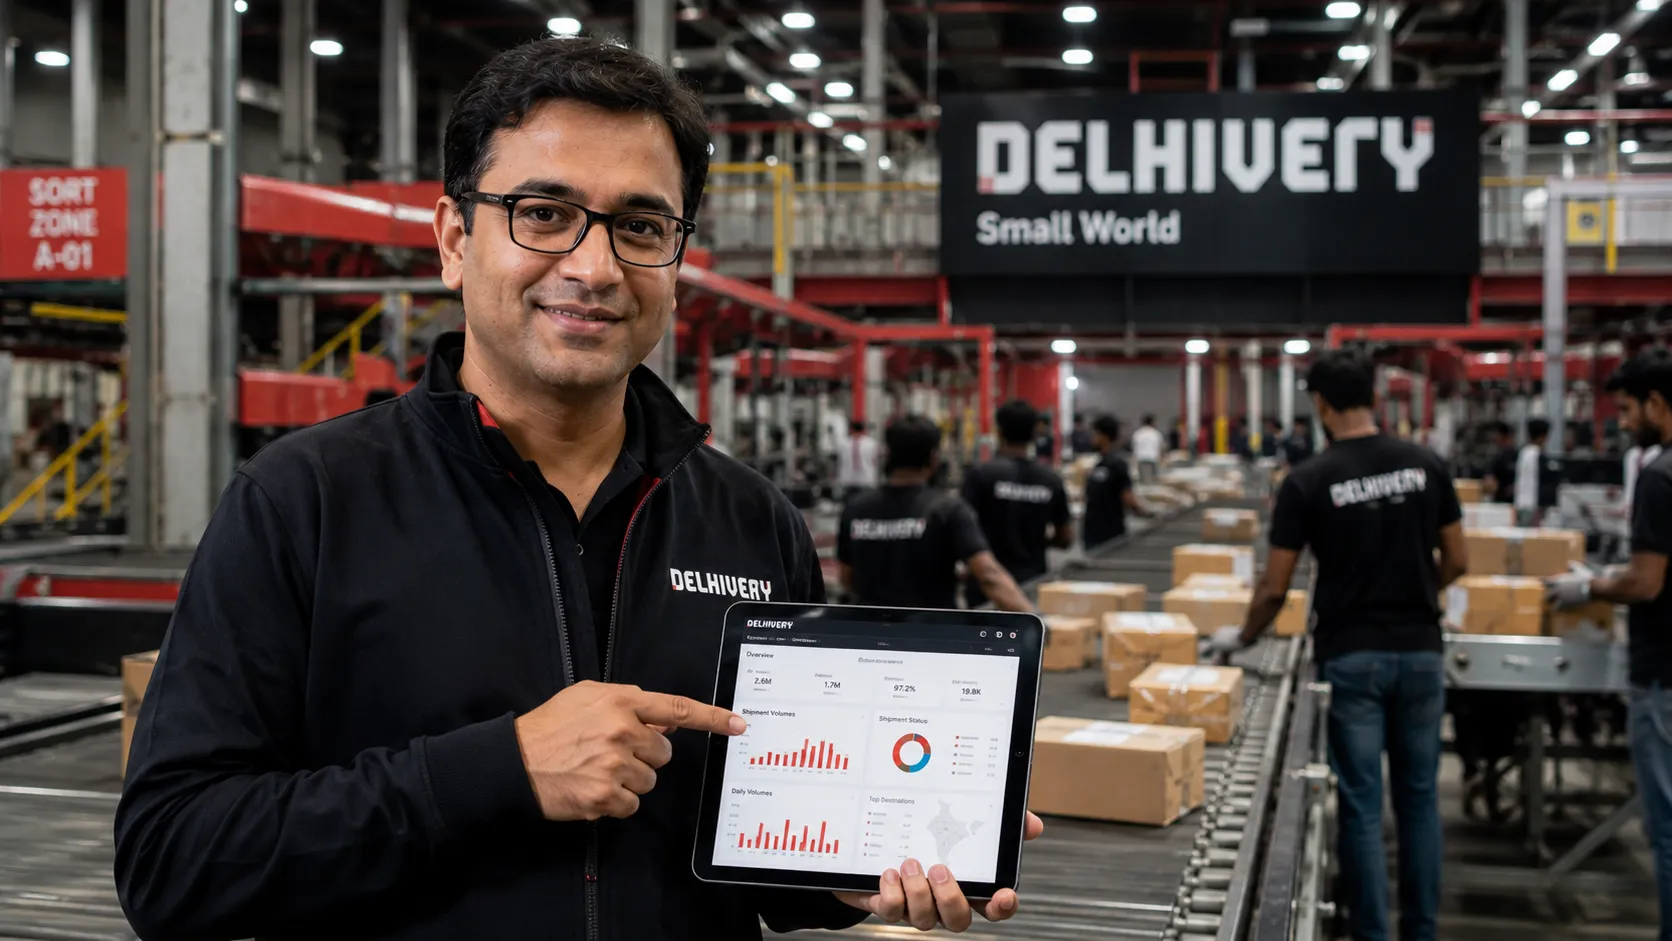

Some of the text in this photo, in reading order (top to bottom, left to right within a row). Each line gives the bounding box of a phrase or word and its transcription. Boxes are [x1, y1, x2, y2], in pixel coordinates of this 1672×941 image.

[976, 117, 1434, 195] DELHIVERY
[28, 176, 99, 206] SORT
[28, 207, 99, 238] ZONE
[976, 209, 1182, 245] Small World
[33, 240, 93, 271] A-01
[669, 568, 772, 602] DELHIVERY
[746, 619, 794, 630] DELHIVERY
[754, 677, 772, 685] 2.6M
[824, 681, 841, 689] 1.7M
[893, 684, 916, 693] 97.2%
[961, 687, 982, 696] 19.8K
[770, 709, 796, 718] Volumes
[878, 715, 929, 724] Shipment Status
[731, 787, 773, 797] Daily Volumes
[869, 795, 880, 805] Top
